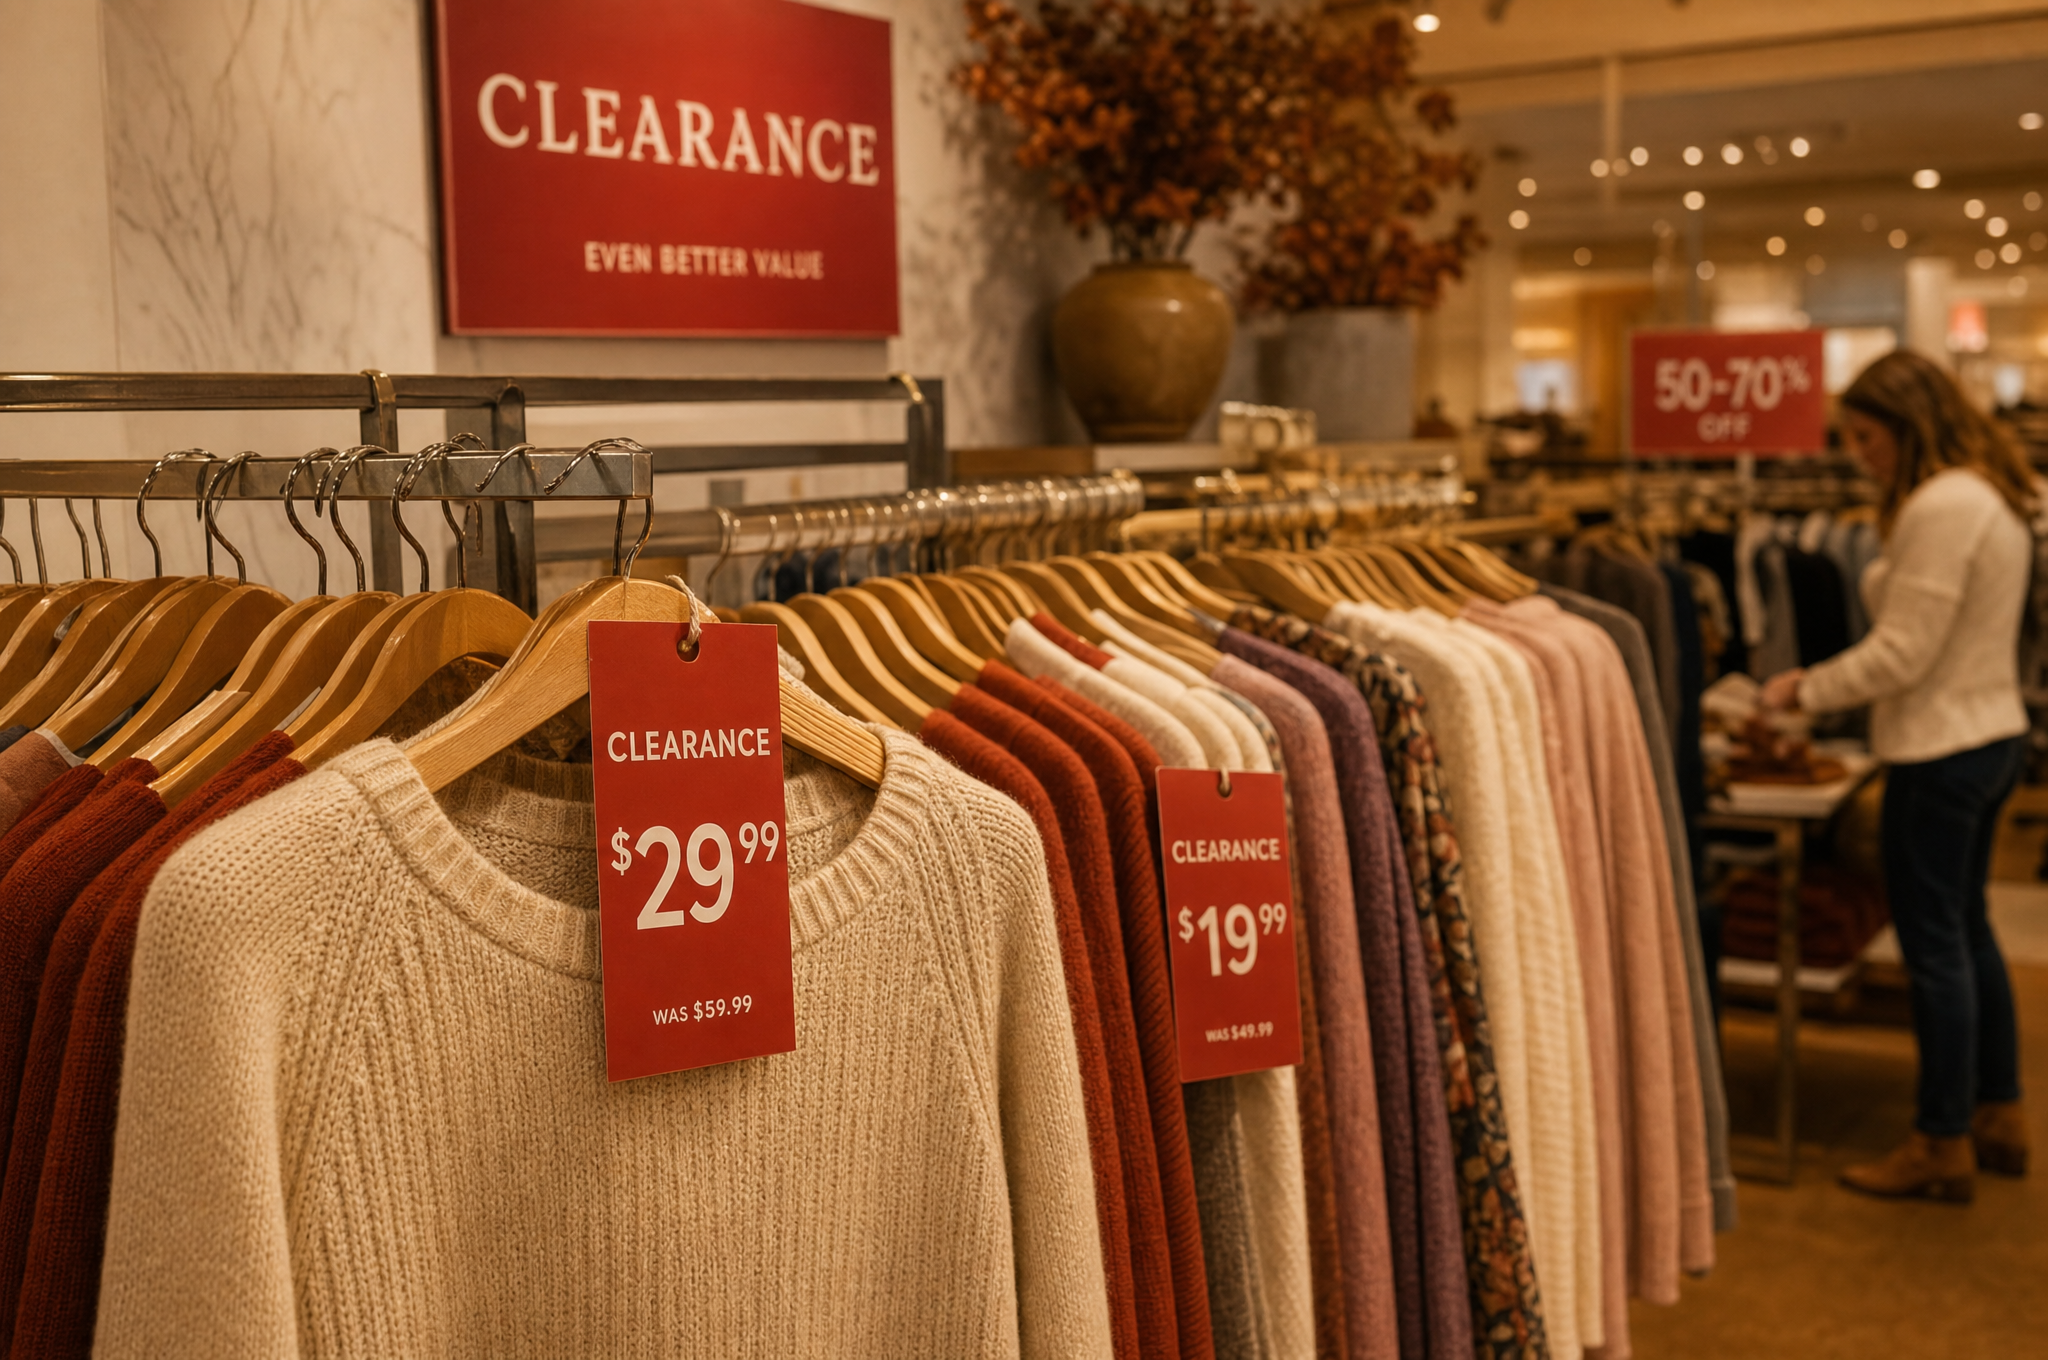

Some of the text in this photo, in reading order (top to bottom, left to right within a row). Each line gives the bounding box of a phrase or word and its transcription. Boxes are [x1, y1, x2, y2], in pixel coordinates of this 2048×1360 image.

[478, 73, 879, 186] CLEARANCE
[584, 241, 823, 280] EVEN BETTER VALUE
[1655, 356, 1811, 411] 50-70%
[1697, 413, 1751, 442] OFF
[607, 727, 771, 763] CLEARANCE
[1171, 837, 1281, 864] CLEARANCE
[652, 994, 752, 1026] WAS $59.99
[1205, 1021, 1274, 1043] WAS $49.99
